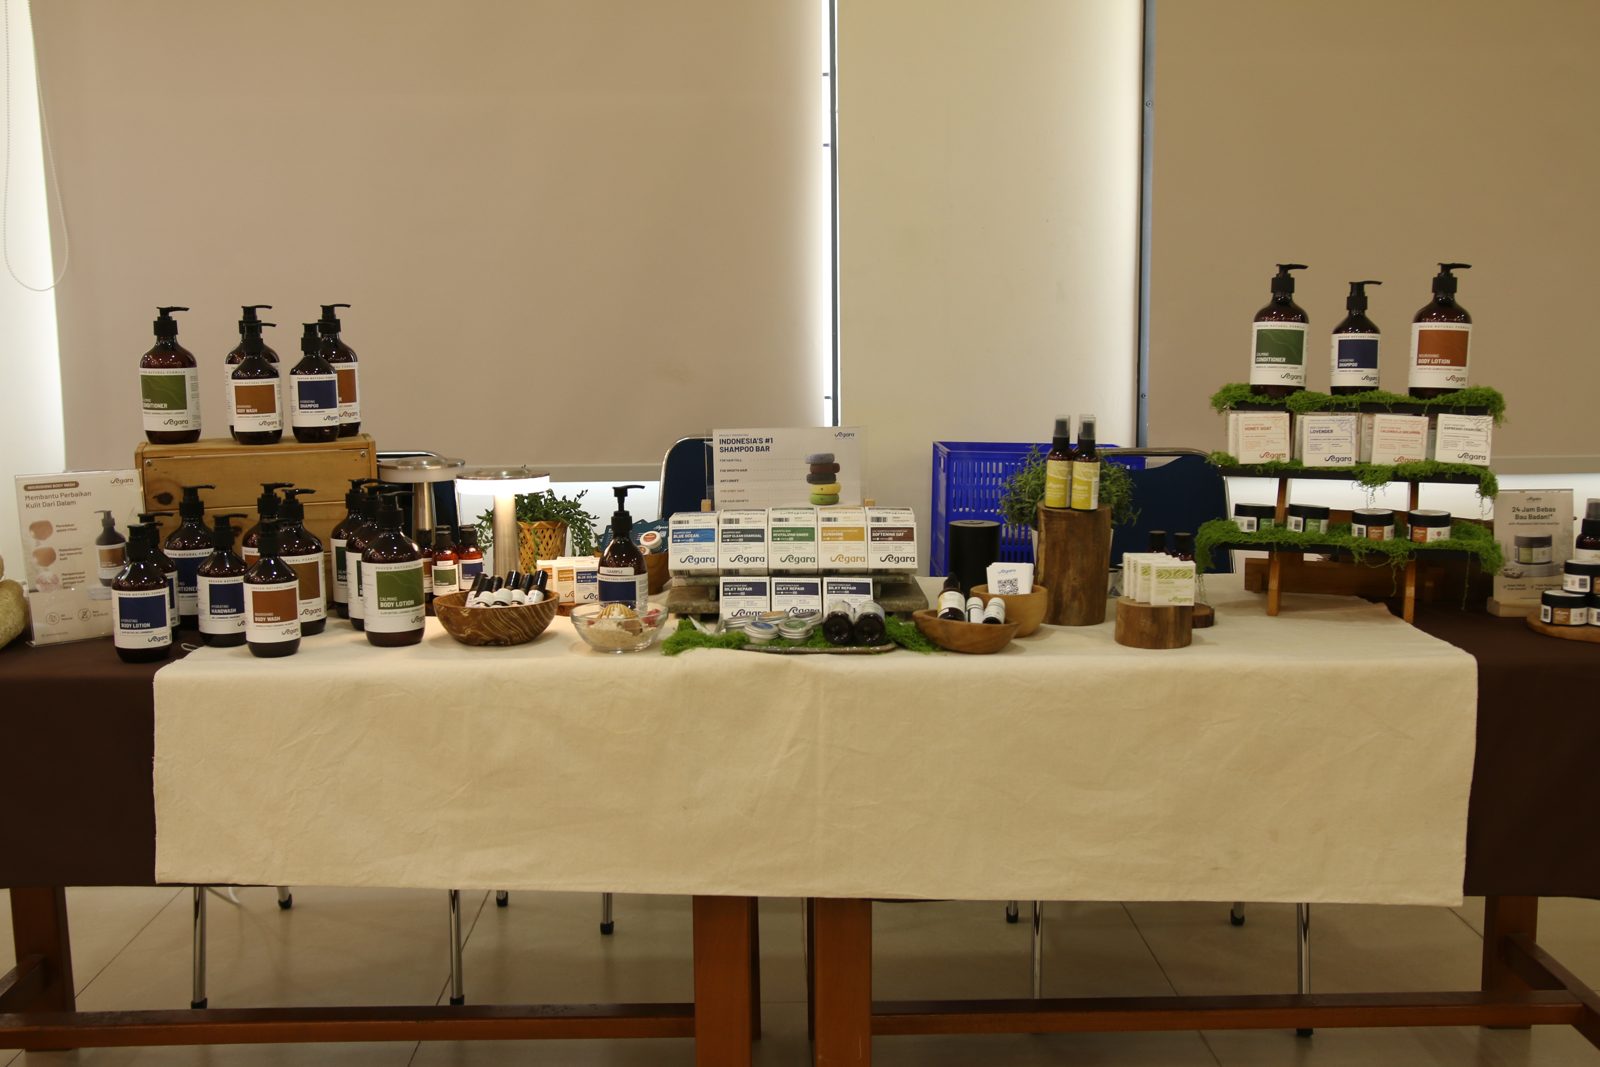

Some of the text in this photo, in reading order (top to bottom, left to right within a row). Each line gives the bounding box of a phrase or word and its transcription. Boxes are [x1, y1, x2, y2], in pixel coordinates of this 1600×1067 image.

[164, 418, 189, 426] Segara
[1324, 455, 1352, 463] Segara
[1458, 452, 1486, 461] Segara
[680, 555, 716, 564] Segara
[730, 554, 765, 564] Segara
[780, 554, 816, 564] Segara
[830, 554, 865, 564] Segara
[880, 554, 916, 564] Segara
